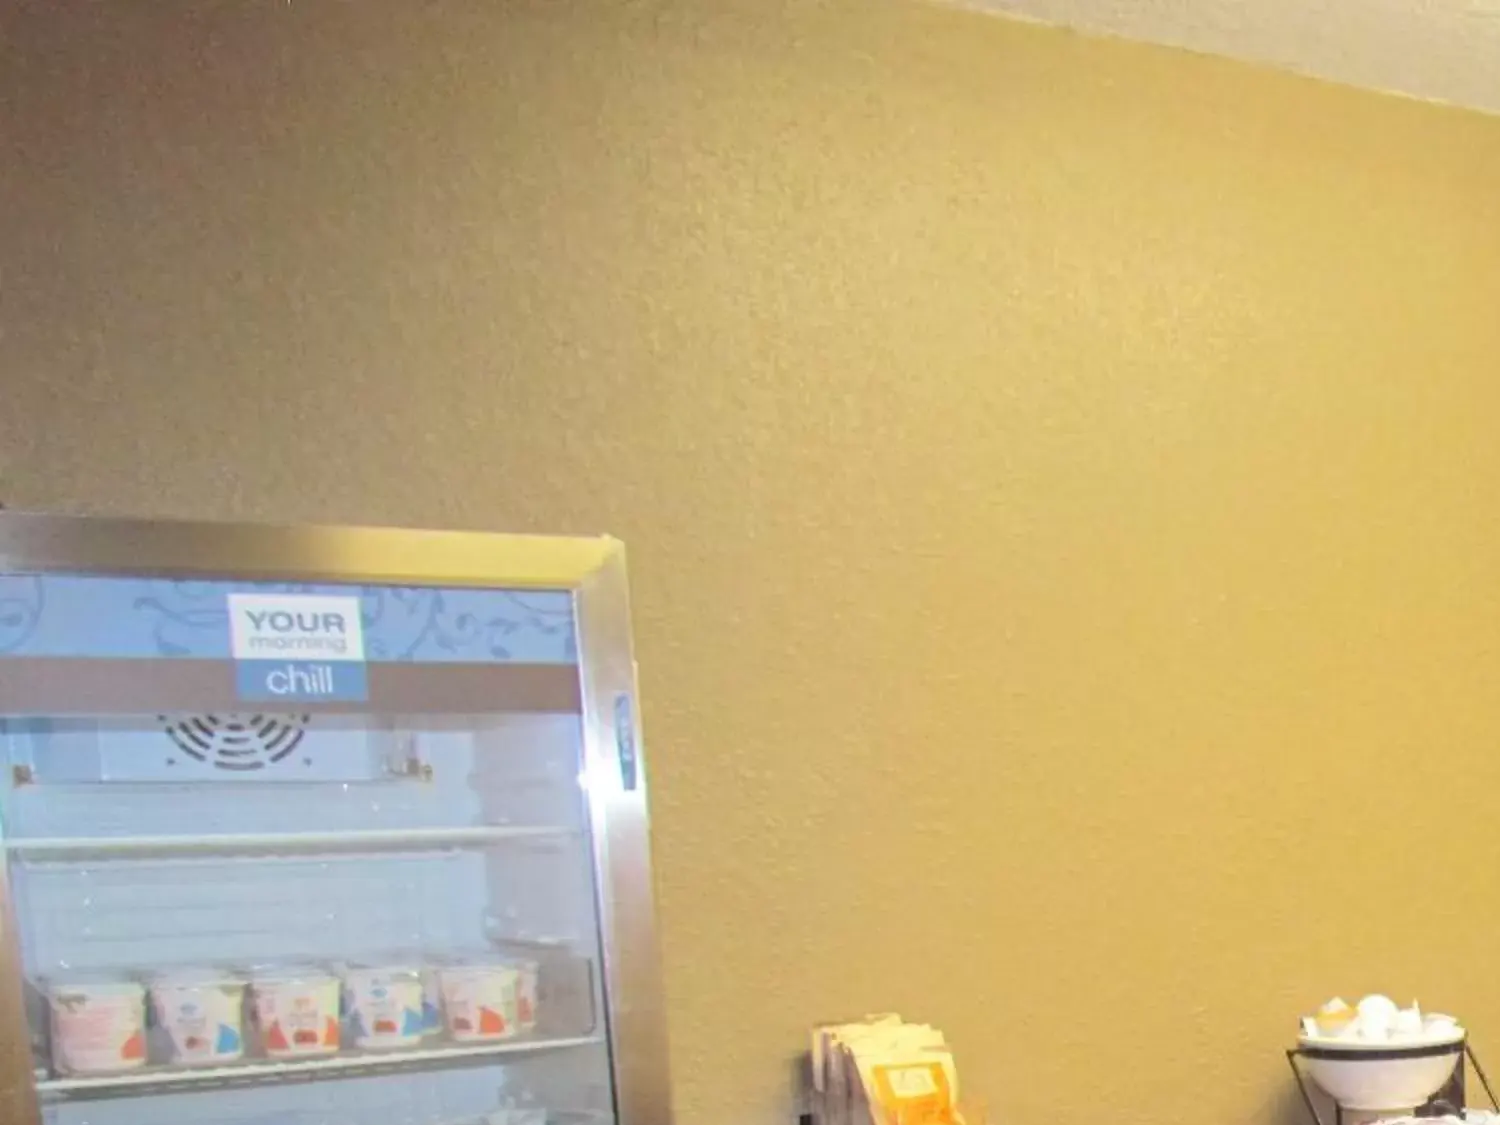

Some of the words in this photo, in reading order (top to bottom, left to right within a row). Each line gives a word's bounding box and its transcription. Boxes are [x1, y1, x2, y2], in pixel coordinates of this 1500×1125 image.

[244, 609, 348, 634] YOUR
[248, 636, 349, 654] morning
[265, 663, 334, 695] chill
